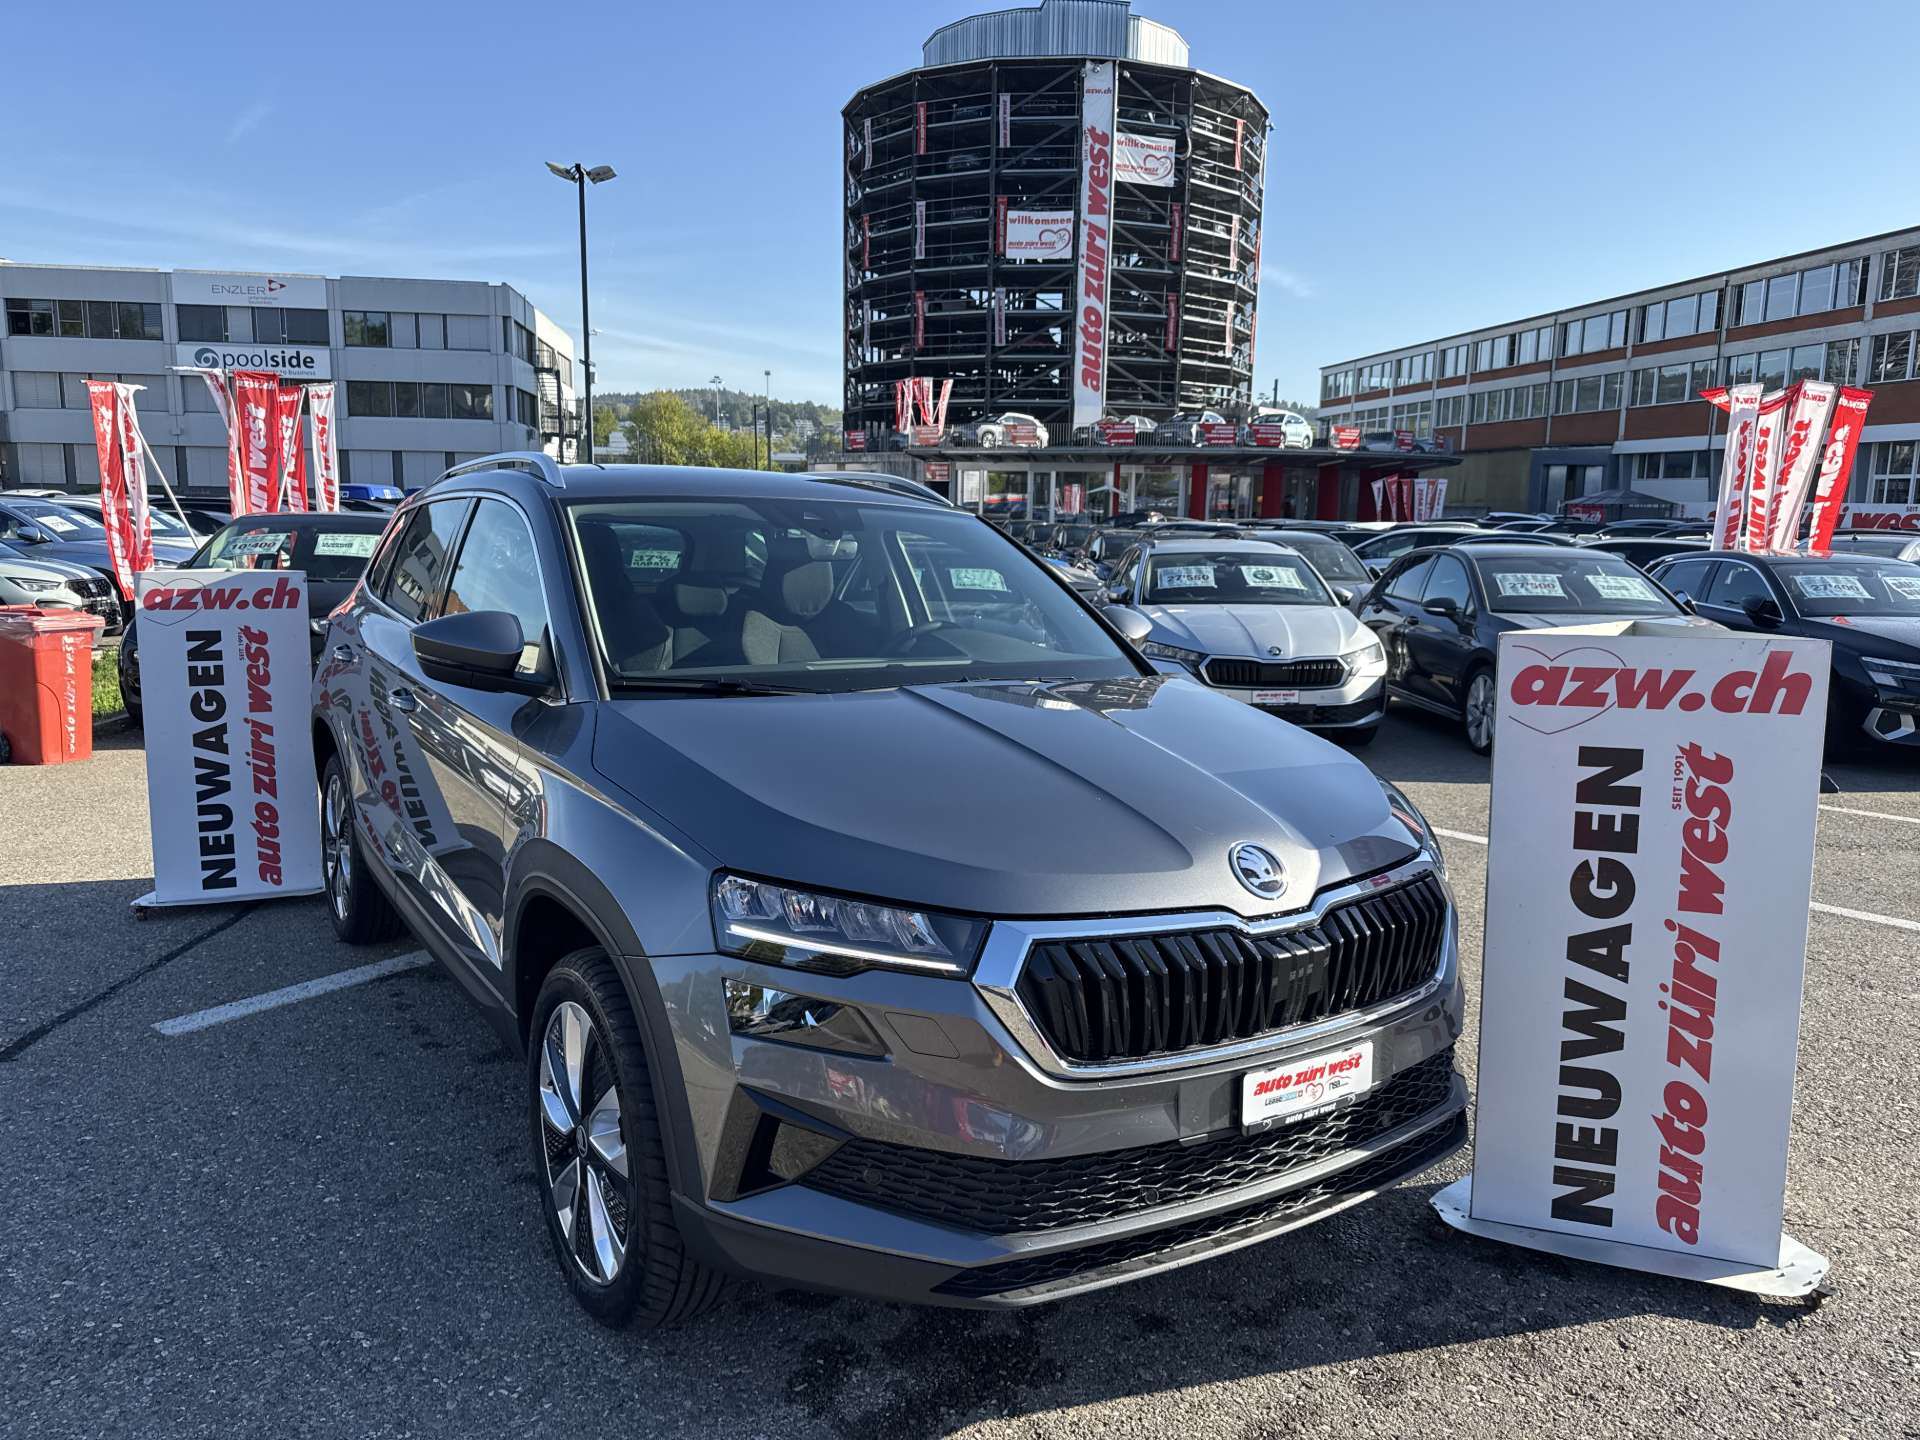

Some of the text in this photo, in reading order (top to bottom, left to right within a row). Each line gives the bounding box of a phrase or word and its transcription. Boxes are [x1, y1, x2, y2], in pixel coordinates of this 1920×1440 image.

[1085, 87, 1112, 95] azw.ch
[1116, 137, 1174, 153] willkommen
[1008, 215, 1073, 225] willkommen
[1079, 125, 1110, 393] auto züri west
[211, 284, 266, 295] ENZLER
[222, 349, 315, 369] poolside
[247, 402, 268, 469] west
[1752, 426, 1771, 491] west
[231, 541, 276, 550] 10'400
[142, 577, 301, 611] azw.ch
[1510, 650, 1813, 715] azw.ch
[185, 630, 238, 891] NEUWAGEN
[238, 625, 283, 886] auto züri west
[1671, 754, 1686, 811] SEIT 1991
[1550, 745, 1645, 1228] NEUWAGEN
[1650, 741, 1734, 1246] auto züri west
[1253, 1074, 1293, 1096] auto
[1293, 1062, 1327, 1086] züri
[1328, 1053, 1363, 1075] west
[1285, 1112, 1303, 1124] auto
[1319, 1102, 1337, 1115] west
